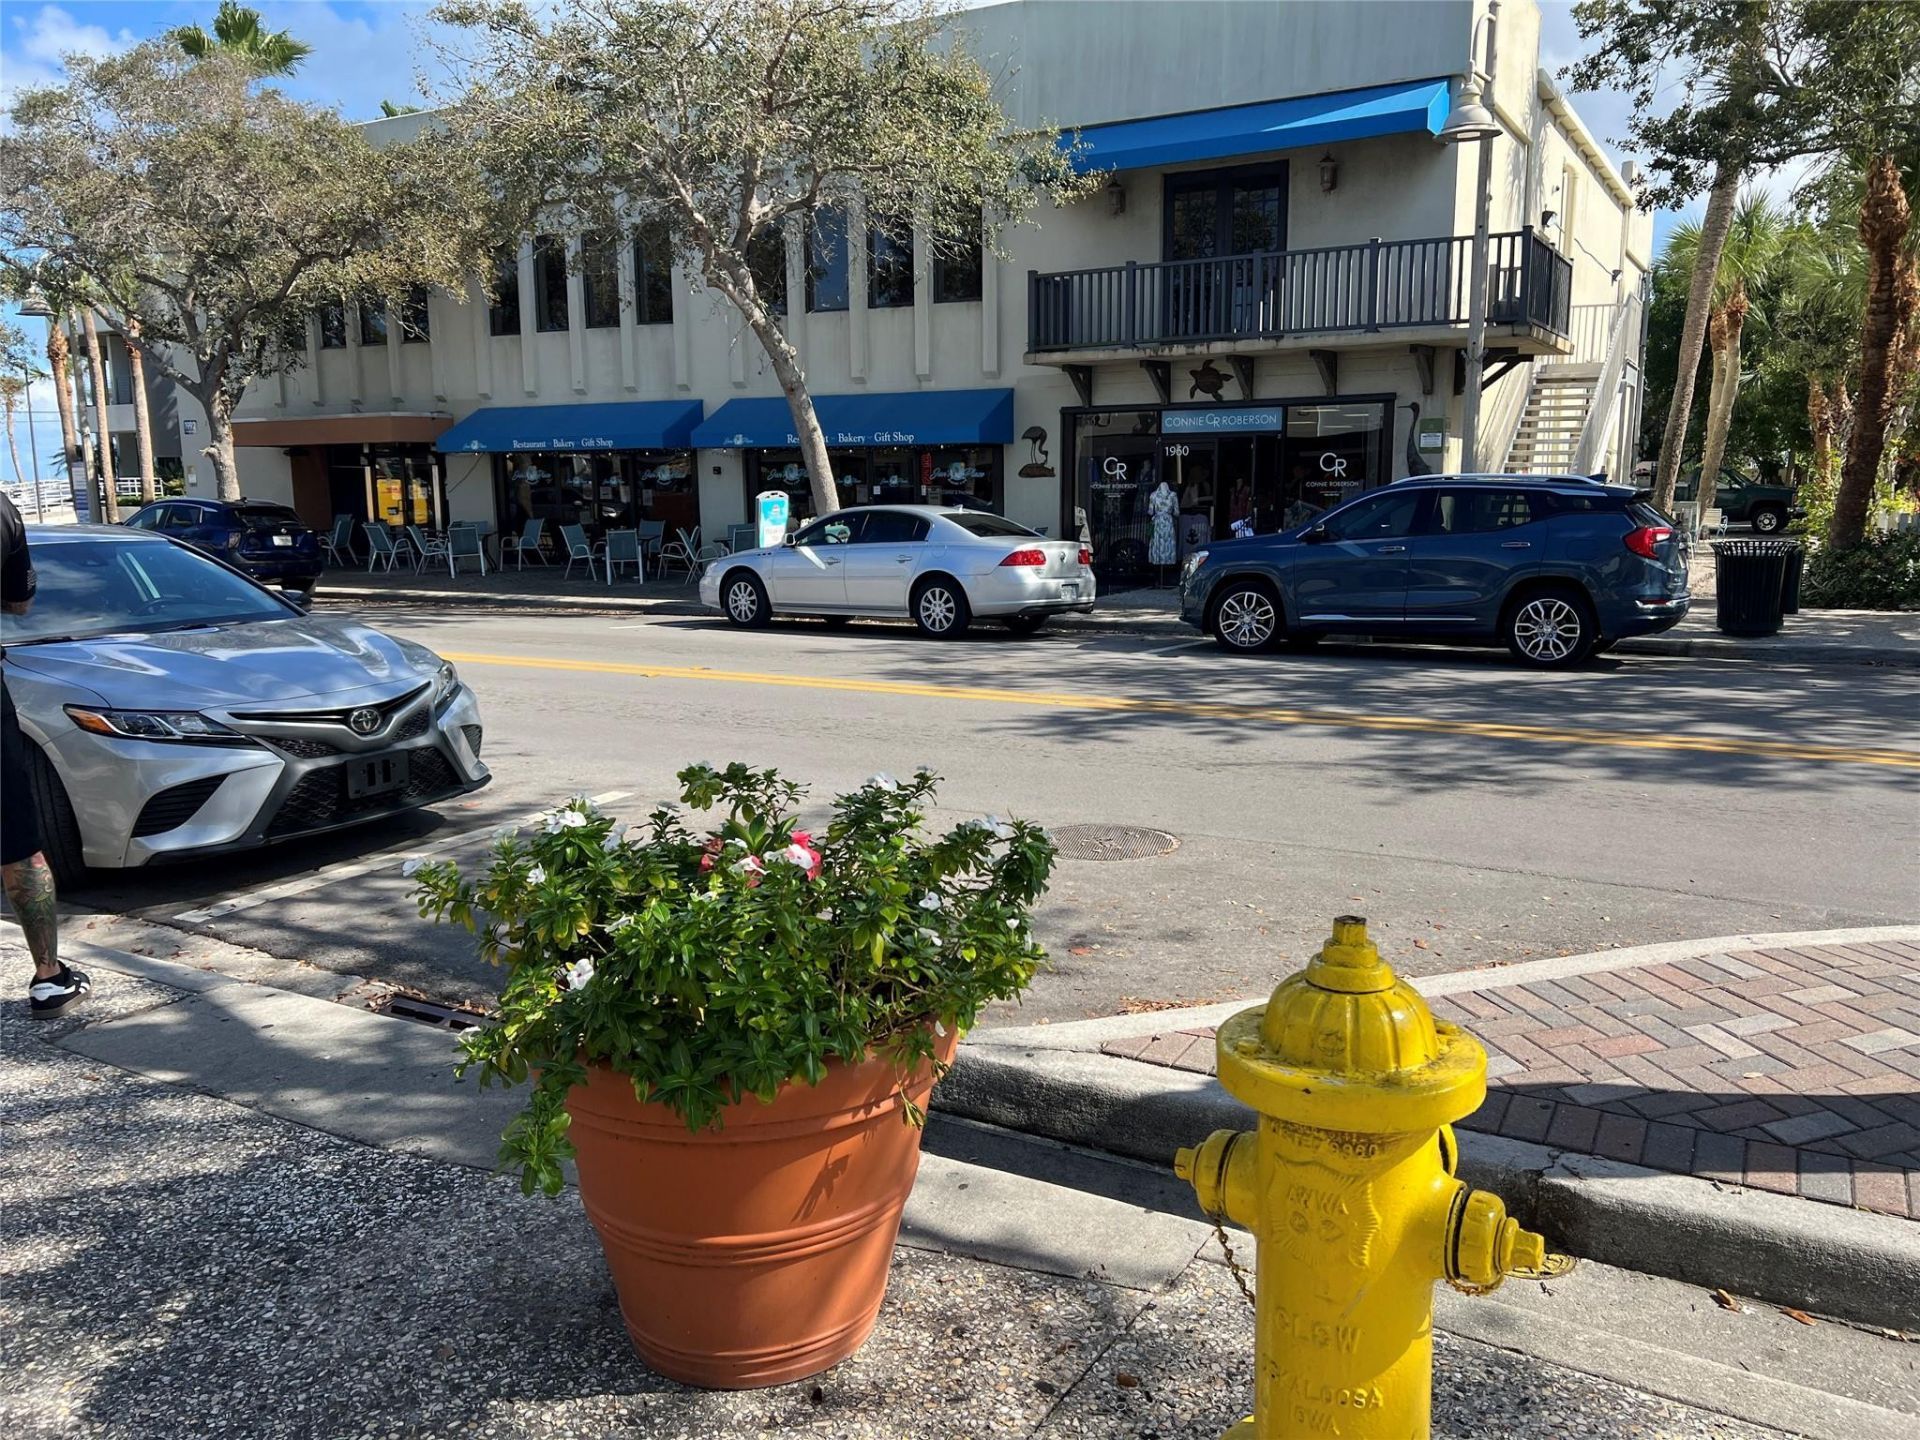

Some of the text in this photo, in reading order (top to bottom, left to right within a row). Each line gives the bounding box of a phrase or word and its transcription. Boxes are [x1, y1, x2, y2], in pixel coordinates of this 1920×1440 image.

[1164, 413, 1277, 429] CONNIE CR ROBERSON
[512, 438, 614, 449] Restaurant Bakery Gift Shop
[838, 433, 865, 444] Bakery
[874, 431, 891, 442] Gift
[893, 431, 915, 444] Shop
[1164, 445, 1190, 456] 1960
[1103, 456, 1127, 480] CR
[1319, 452, 1347, 478] CR
